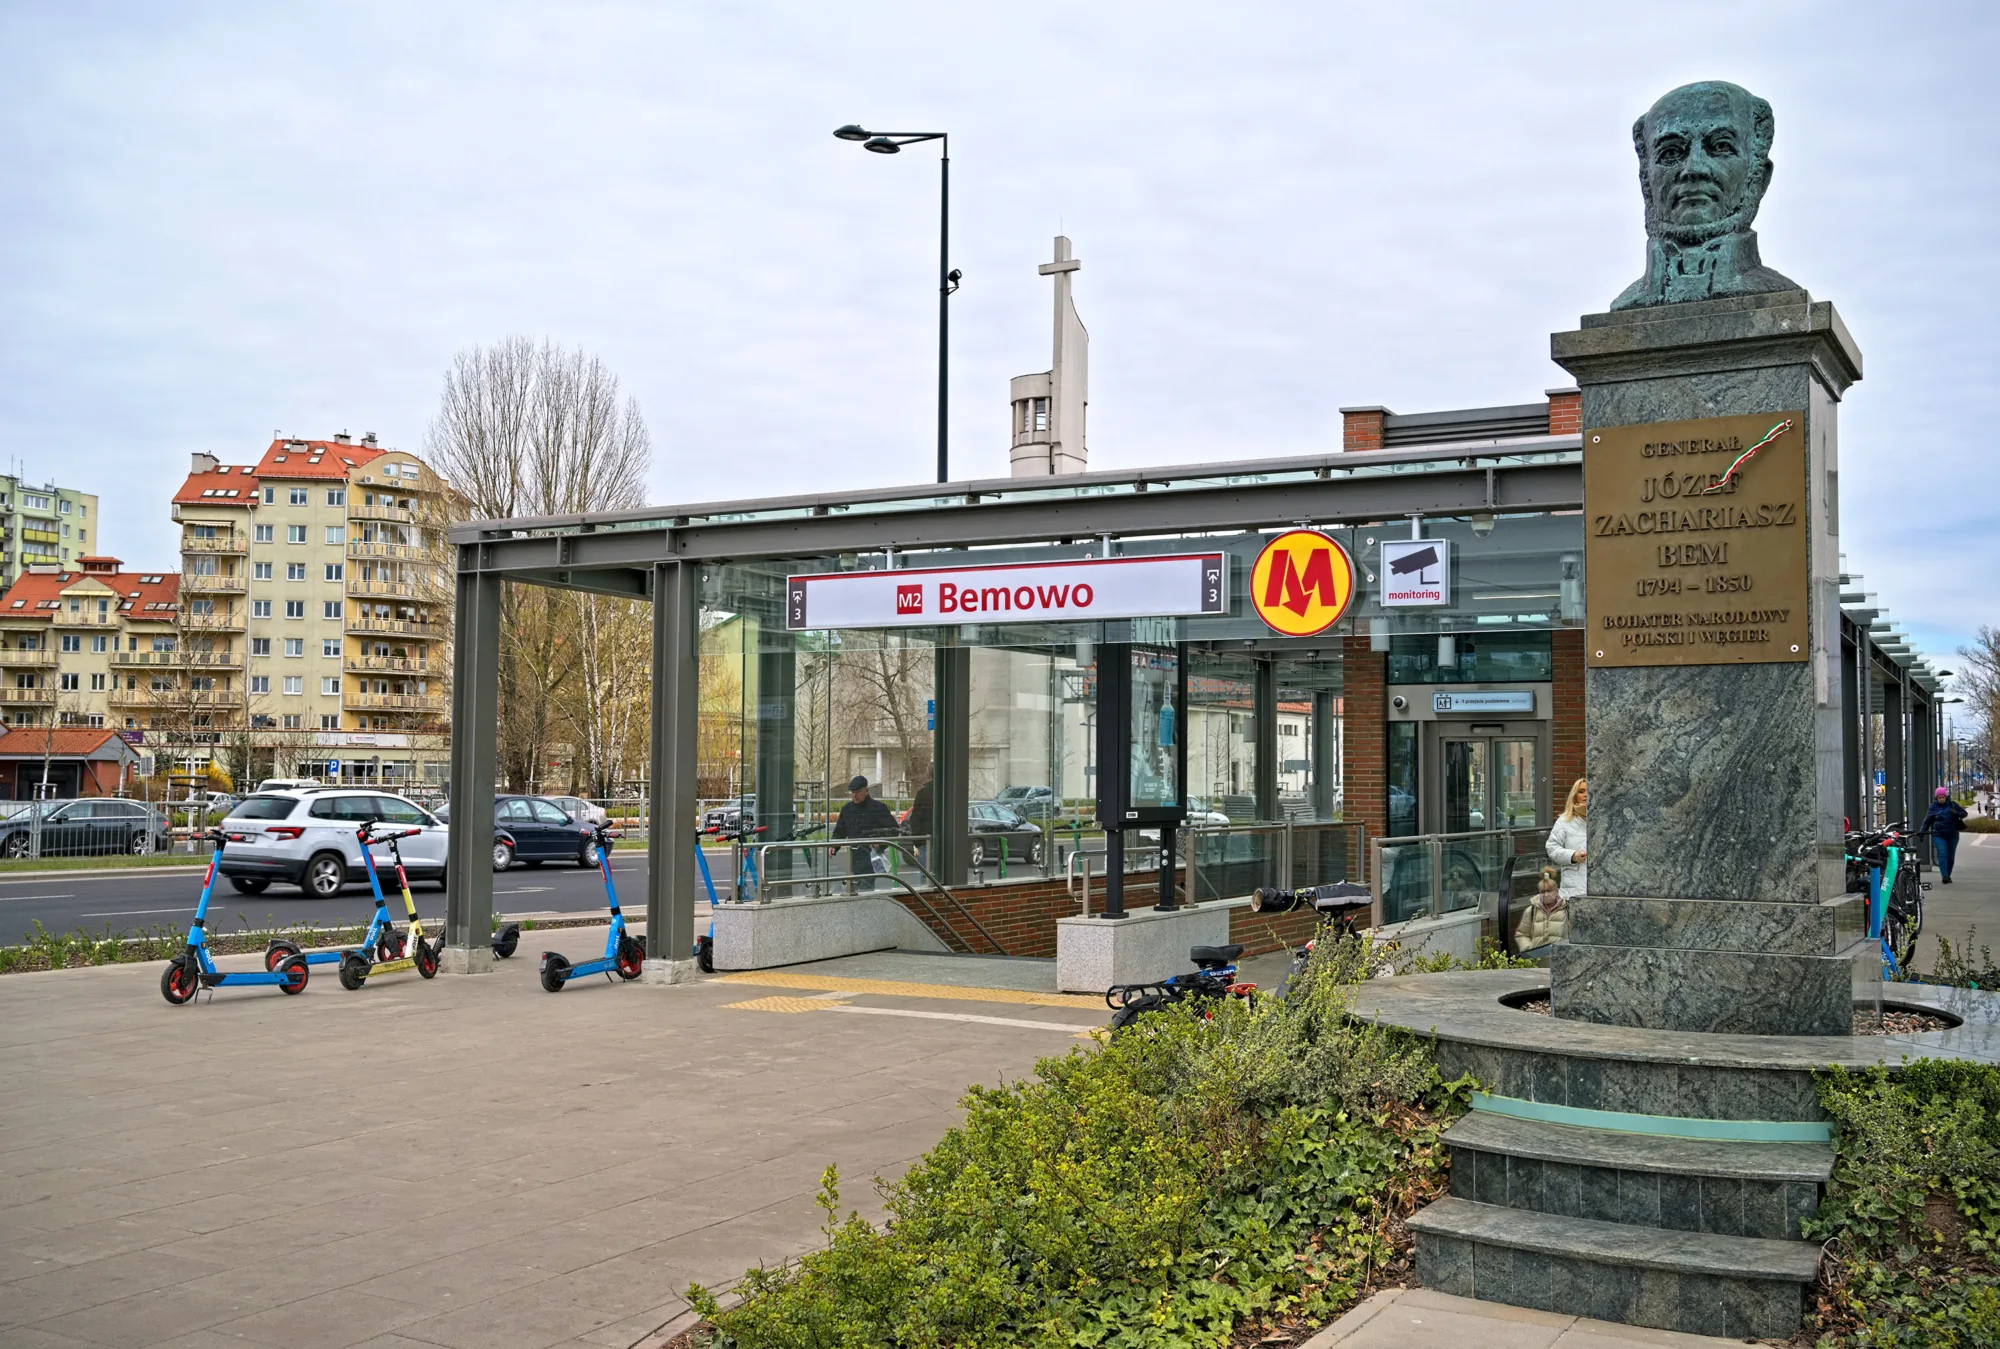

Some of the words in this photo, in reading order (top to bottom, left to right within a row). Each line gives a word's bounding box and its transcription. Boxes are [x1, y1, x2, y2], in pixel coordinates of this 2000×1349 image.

[1641, 436, 1742, 458] GENERAŁ
[1641, 471, 1742, 502] JÓZEF
[1594, 502, 1795, 537] ZACHARIASZ
[1658, 542, 1728, 567] BEM
[898, 592, 921, 608] M2
[939, 582, 1094, 613] Bemowo
[1209, 589, 1217, 602] 3
[1388, 589, 1440, 601] monitoring
[794, 608, 801, 620] 3
[1604, 615, 1682, 629] BOHATER
[1687, 609, 1790, 626] NARODOWY
[1622, 631, 1684, 646] POLSKI
[1689, 631, 1695, 643] I
[1700, 629, 1769, 645] WĘGIER
